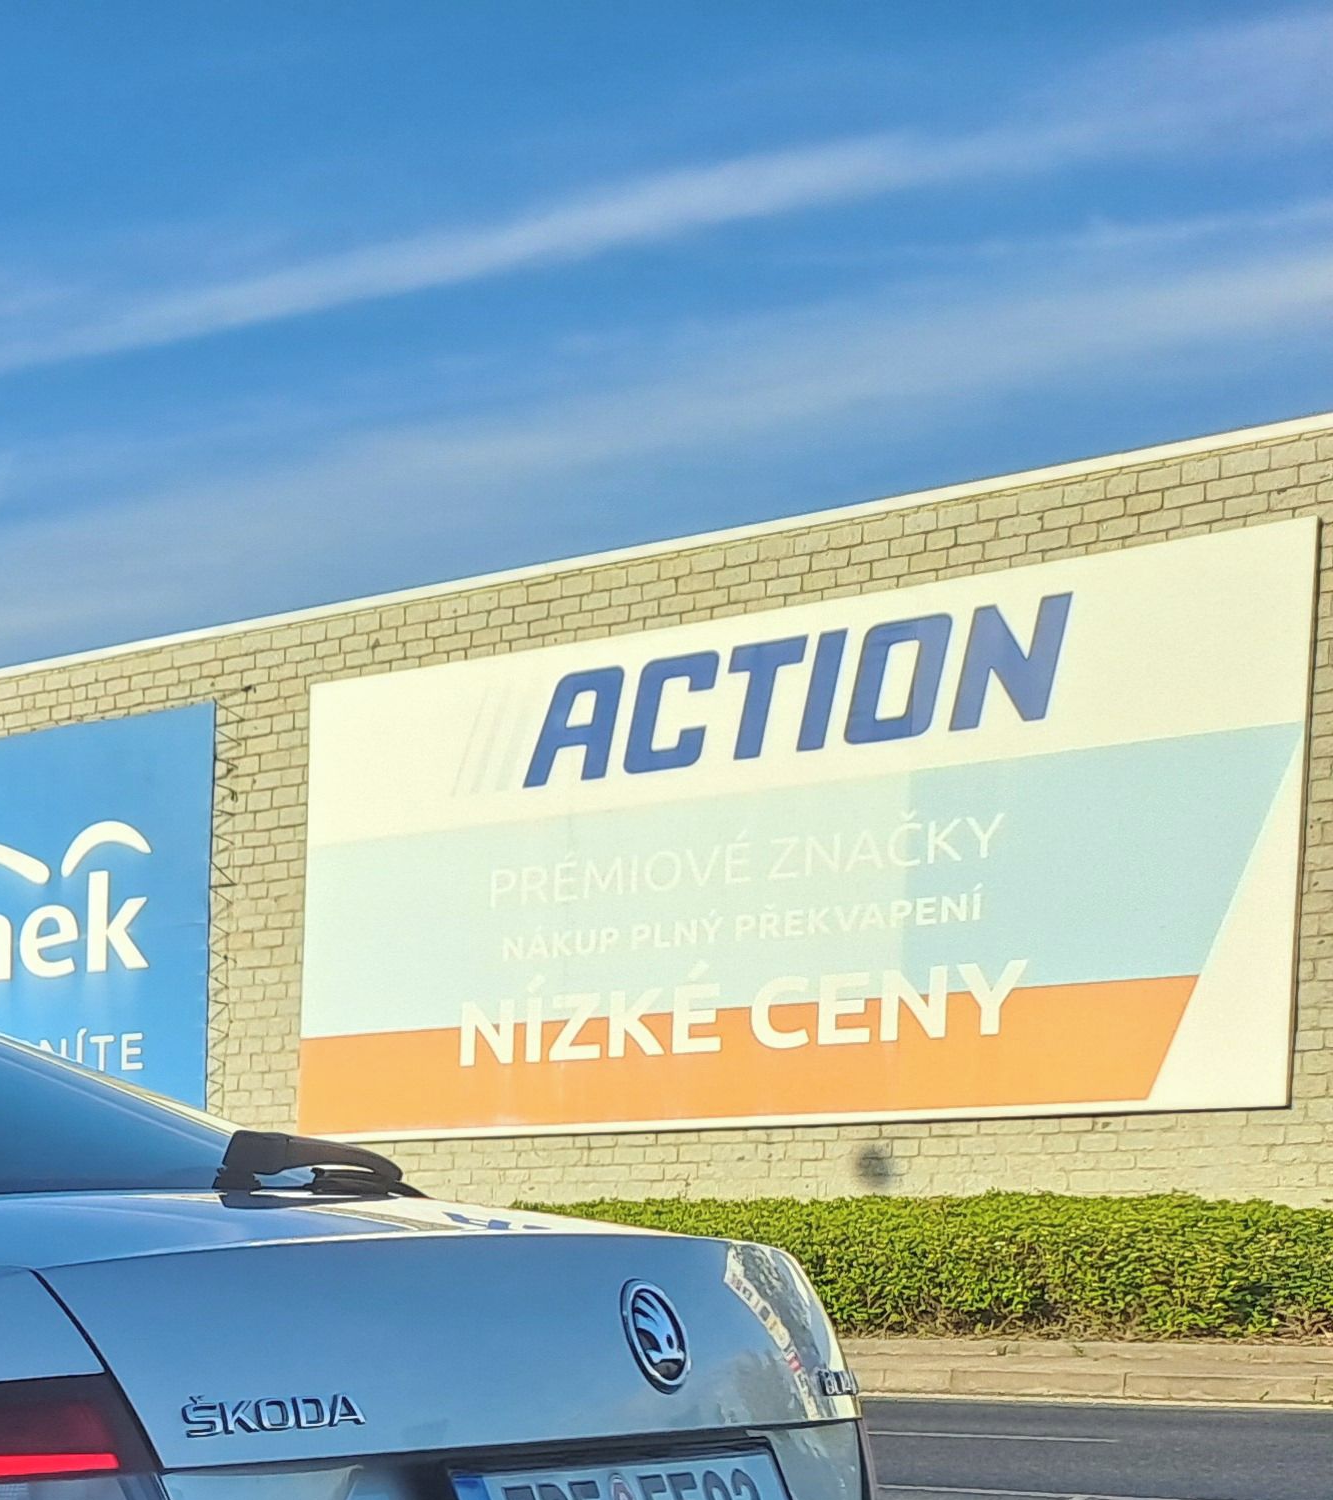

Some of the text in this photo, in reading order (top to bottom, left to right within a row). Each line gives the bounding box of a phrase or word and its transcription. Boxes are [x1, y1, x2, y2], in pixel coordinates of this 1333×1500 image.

[522, 591, 1073, 789] ACTION
[489, 809, 1005, 910] PRÉMIOVÉ ZNAČKY
[501, 882, 983, 961] NÁKUP PLNÝ PŘEKVAPENÍ
[459, 958, 1029, 1068] NÍZKÉ CENY
[181, 1393, 367, 1439] ŠKODA
